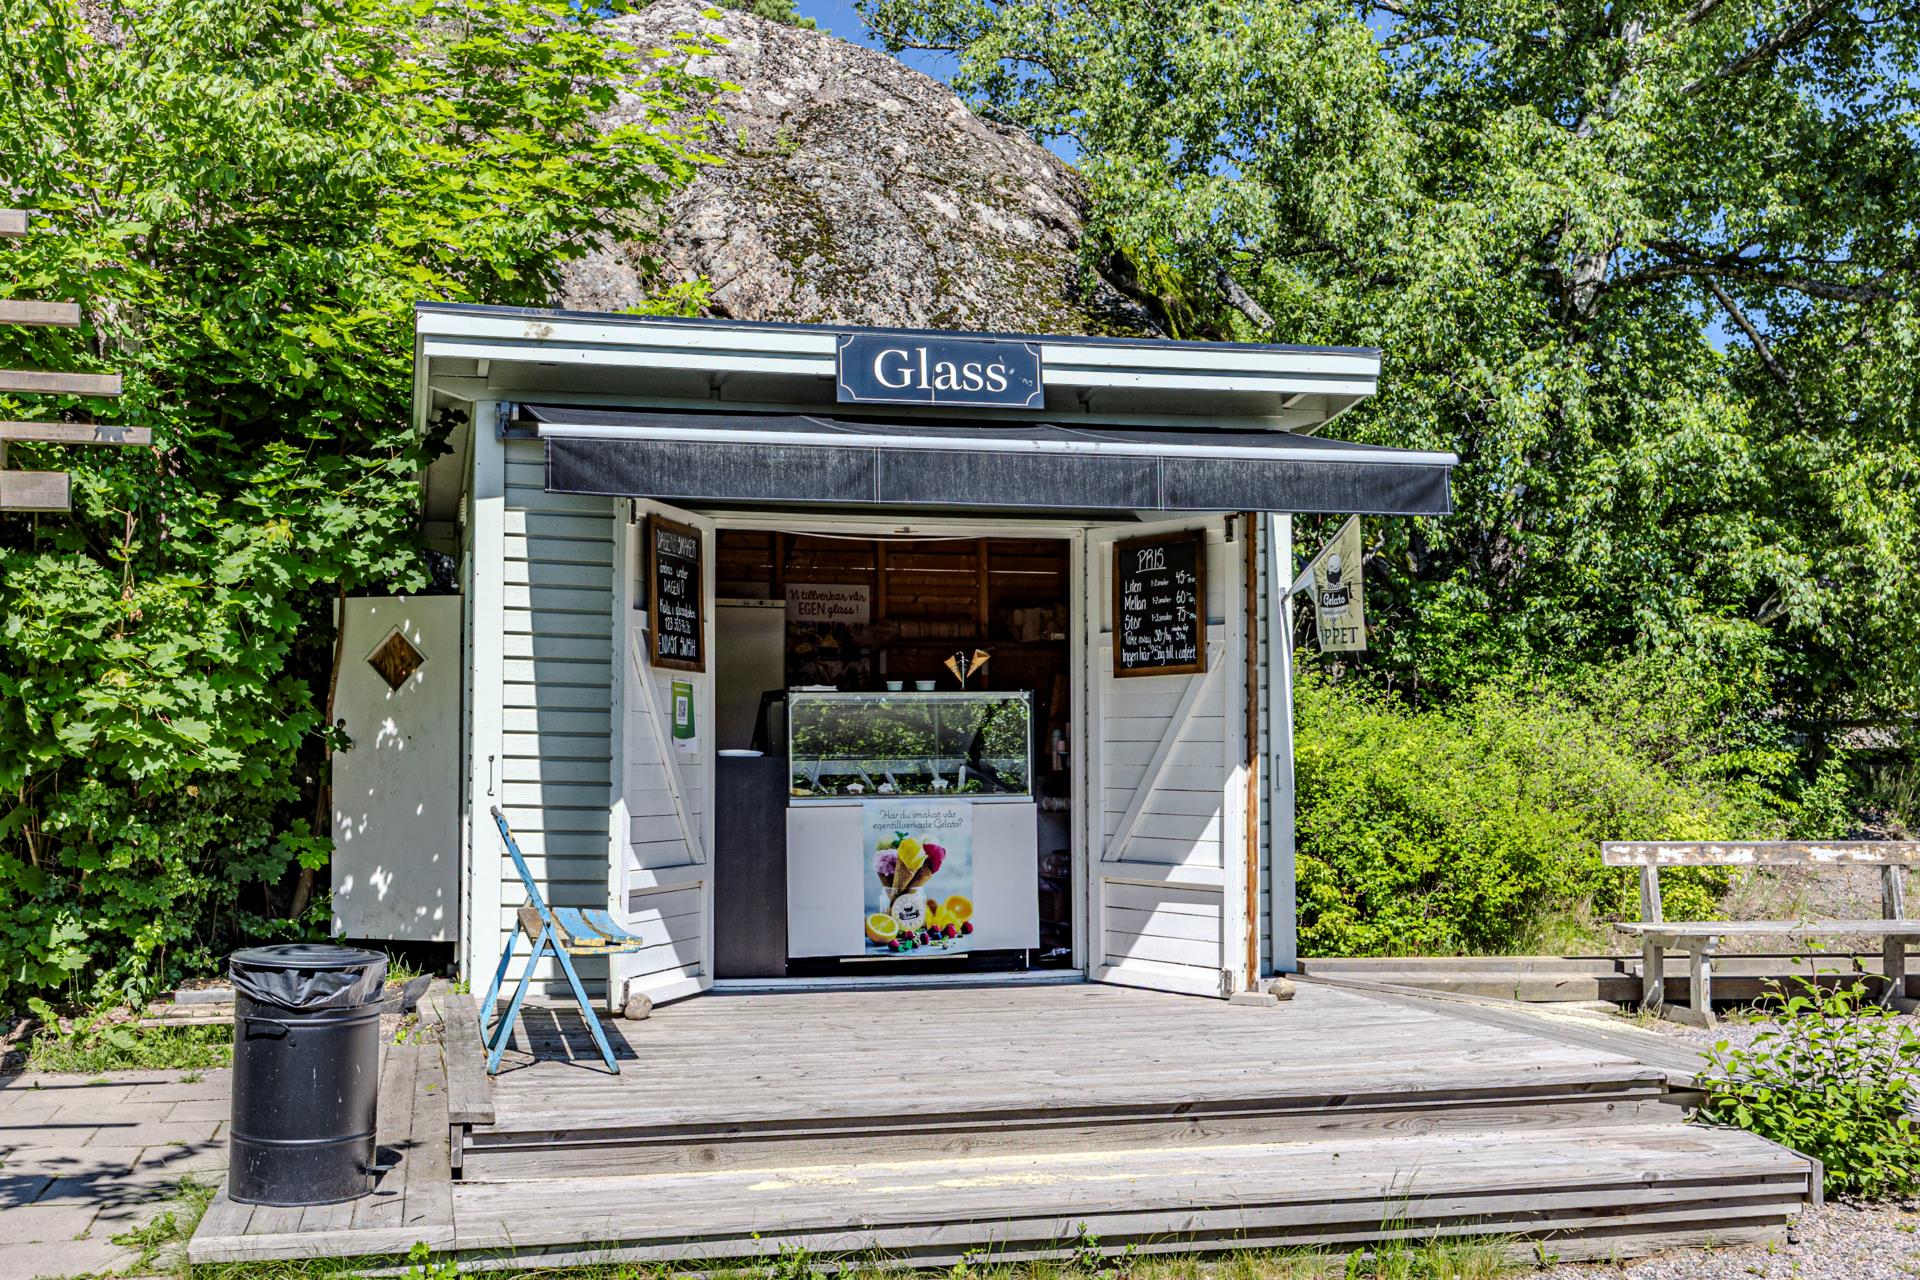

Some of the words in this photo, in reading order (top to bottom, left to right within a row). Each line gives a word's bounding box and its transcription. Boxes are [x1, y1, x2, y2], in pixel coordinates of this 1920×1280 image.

[874, 347, 1008, 393] Glass
[1137, 547, 1165, 571] PRIS
[1124, 579, 1142, 594] Liten
[790, 589, 800, 600] Vi
[801, 589, 848, 602] tillverkar
[849, 591, 867, 602] vår
[1124, 594, 1147, 611] Mellan
[1323, 593, 1346, 607] Gelato
[798, 602, 826, 616] EGEN
[1124, 614, 1142, 631] Stor
[658, 633, 678, 656] ENDAST
[1122, 648, 1139, 668] Ingen
[1166, 644, 1174, 660] till
[879, 809, 899, 820] Har
[900, 810, 911, 819] du
[912, 809, 941, 819] smakat
[943, 810, 957, 819] vår
[873, 820, 932, 831] egentillverkade
[934, 818, 963, 830] Gelato?
